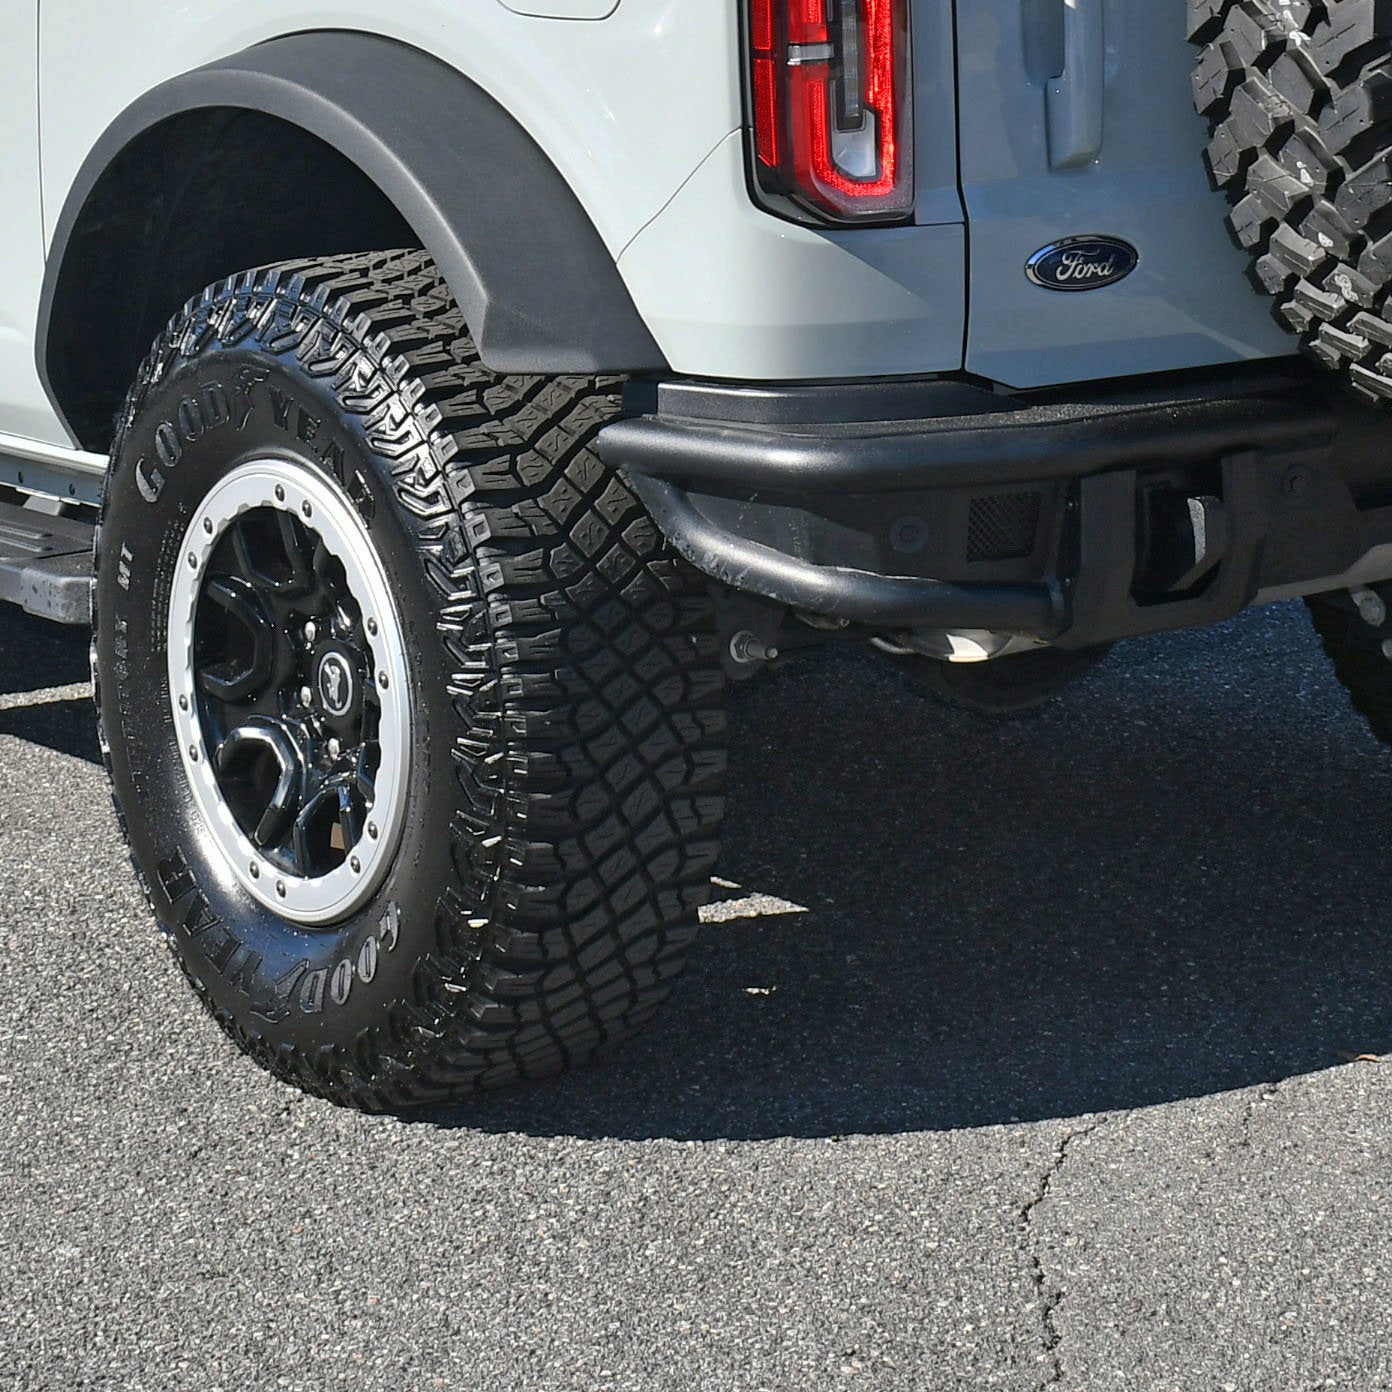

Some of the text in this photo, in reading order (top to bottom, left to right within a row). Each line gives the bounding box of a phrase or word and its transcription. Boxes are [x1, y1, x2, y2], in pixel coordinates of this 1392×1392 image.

[1055, 248, 1116, 282] Ford
[135, 362, 377, 528] GOODYEAR
[157, 845, 401, 1023] GOODYEAR
